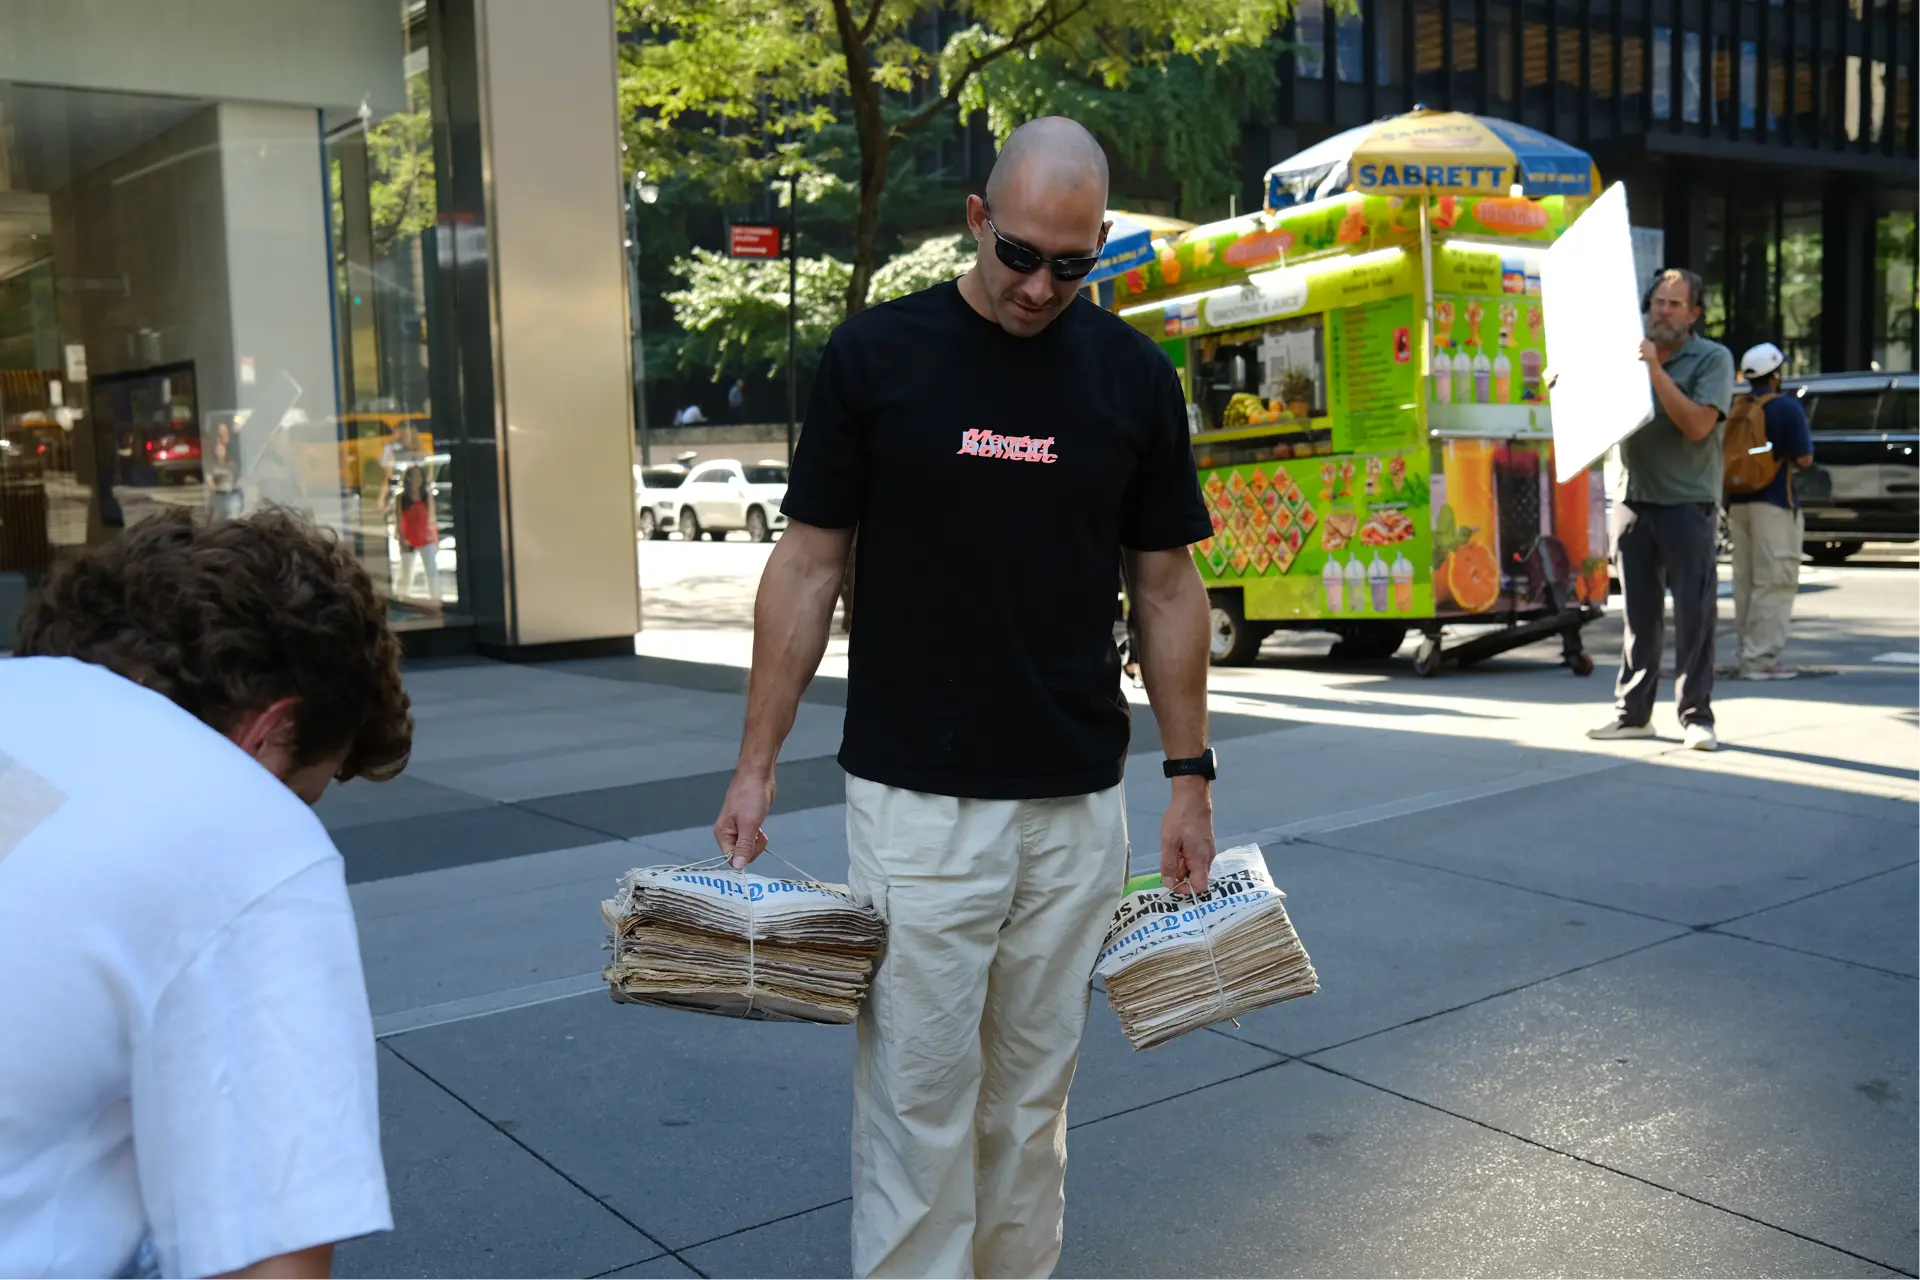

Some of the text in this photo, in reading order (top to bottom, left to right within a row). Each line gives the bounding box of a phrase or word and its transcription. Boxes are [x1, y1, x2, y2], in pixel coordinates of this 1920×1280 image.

[1359, 164, 1507, 187] SABRETT
[1241, 286, 1266, 302] NYC
[672, 874, 765, 901] Tribune
[1181, 889, 1269, 922] Chicago
